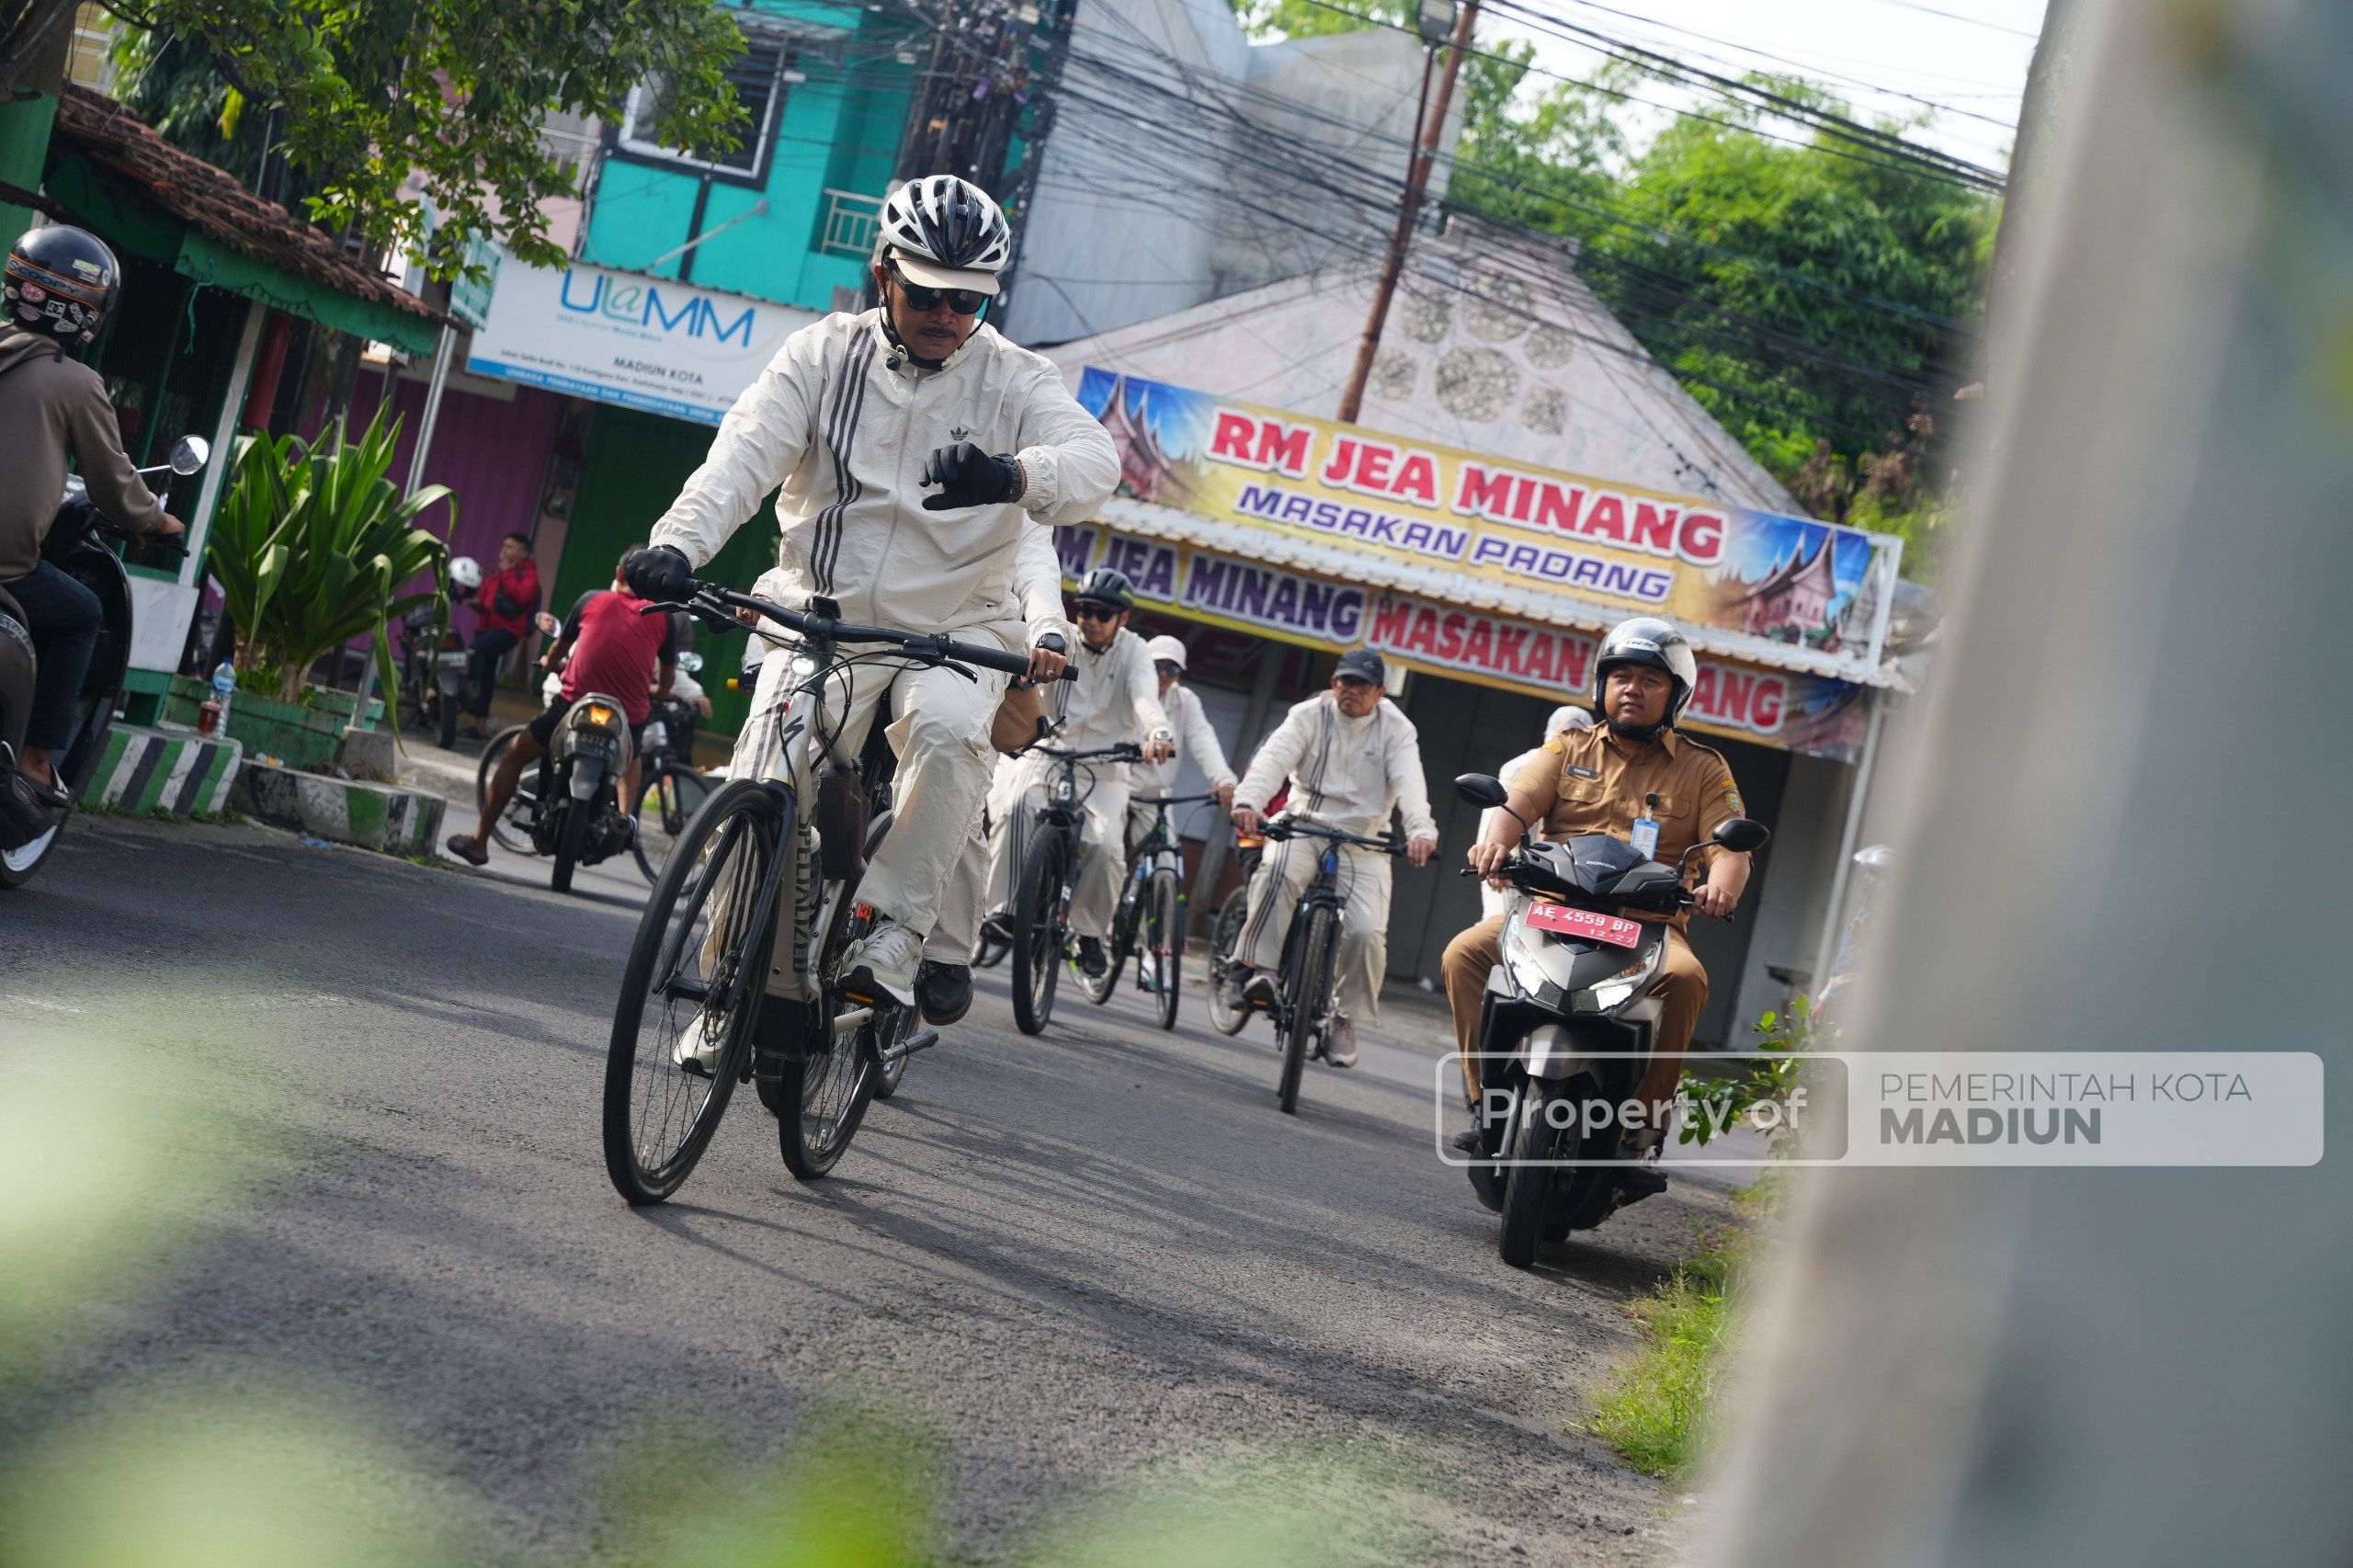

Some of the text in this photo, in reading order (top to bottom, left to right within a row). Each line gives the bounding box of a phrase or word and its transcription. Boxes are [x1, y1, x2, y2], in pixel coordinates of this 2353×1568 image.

[9, 259, 79, 293] SCOOPY
[614, 358, 703, 384] MADIUN KOTA
[1211, 411, 1723, 559] RM JEA MINANG
[1240, 486, 1672, 599] MASAKAN PADANG
[1054, 525, 1784, 728] M JEA MINANG MASAKAN ANG
[1586, 859, 1618, 870] HONDA
[1533, 904, 1634, 934] AE 4559 BP
